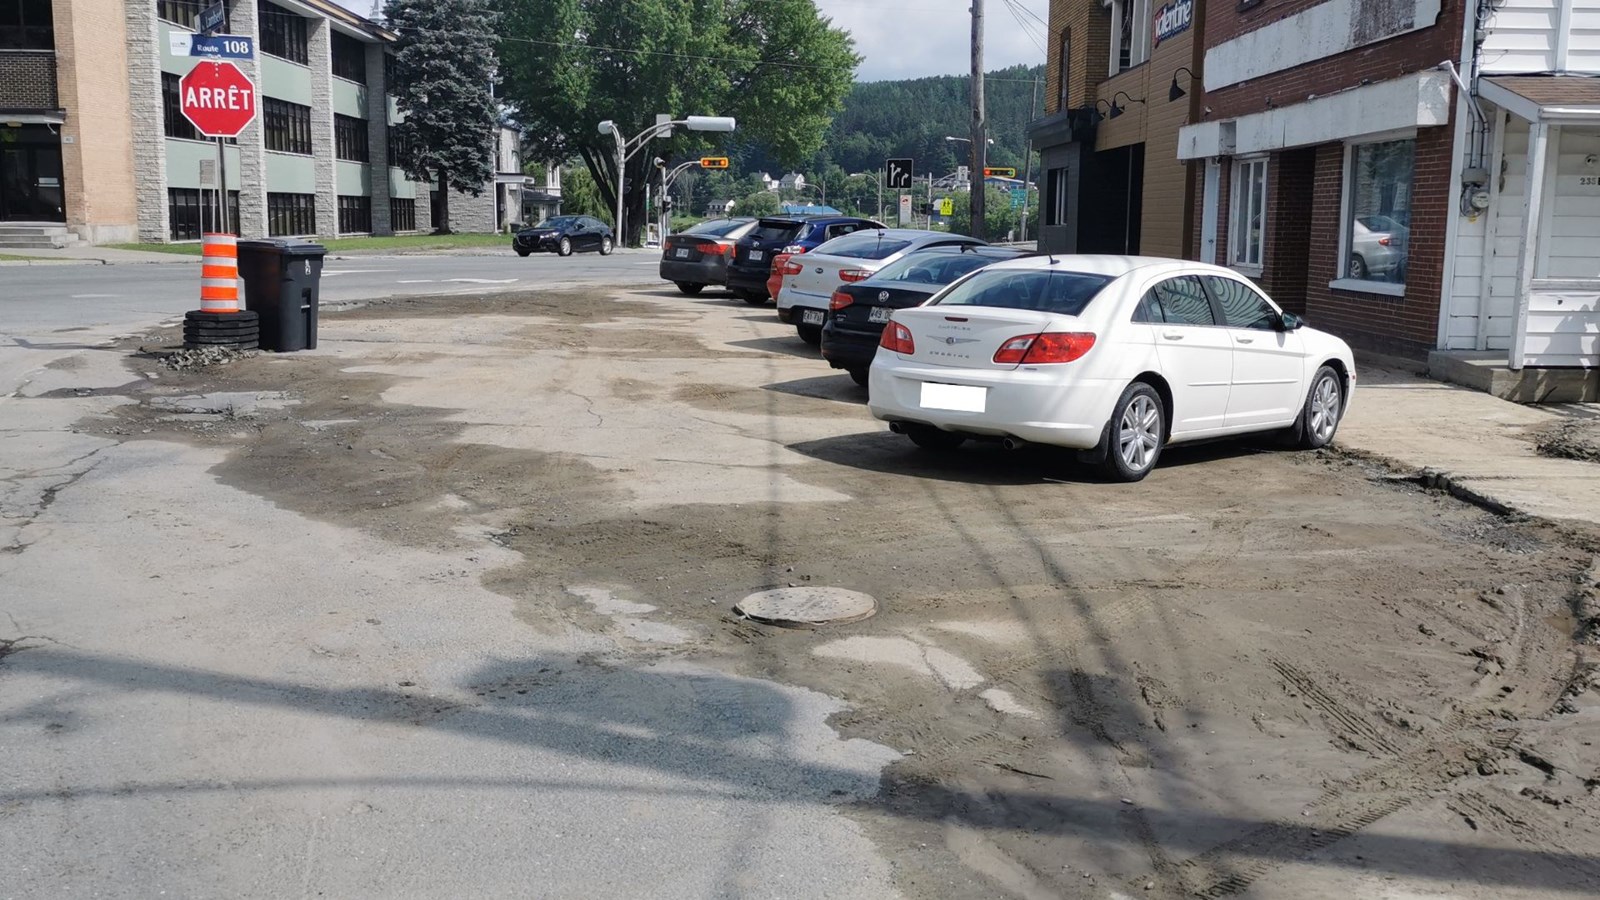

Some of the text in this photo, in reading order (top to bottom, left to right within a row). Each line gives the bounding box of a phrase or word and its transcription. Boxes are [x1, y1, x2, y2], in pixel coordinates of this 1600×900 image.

[197, 44, 219, 53] Route
[223, 40, 249, 54] 108
[185, 85, 251, 110] ARRÊT
[1580, 177, 1600, 186] 235
